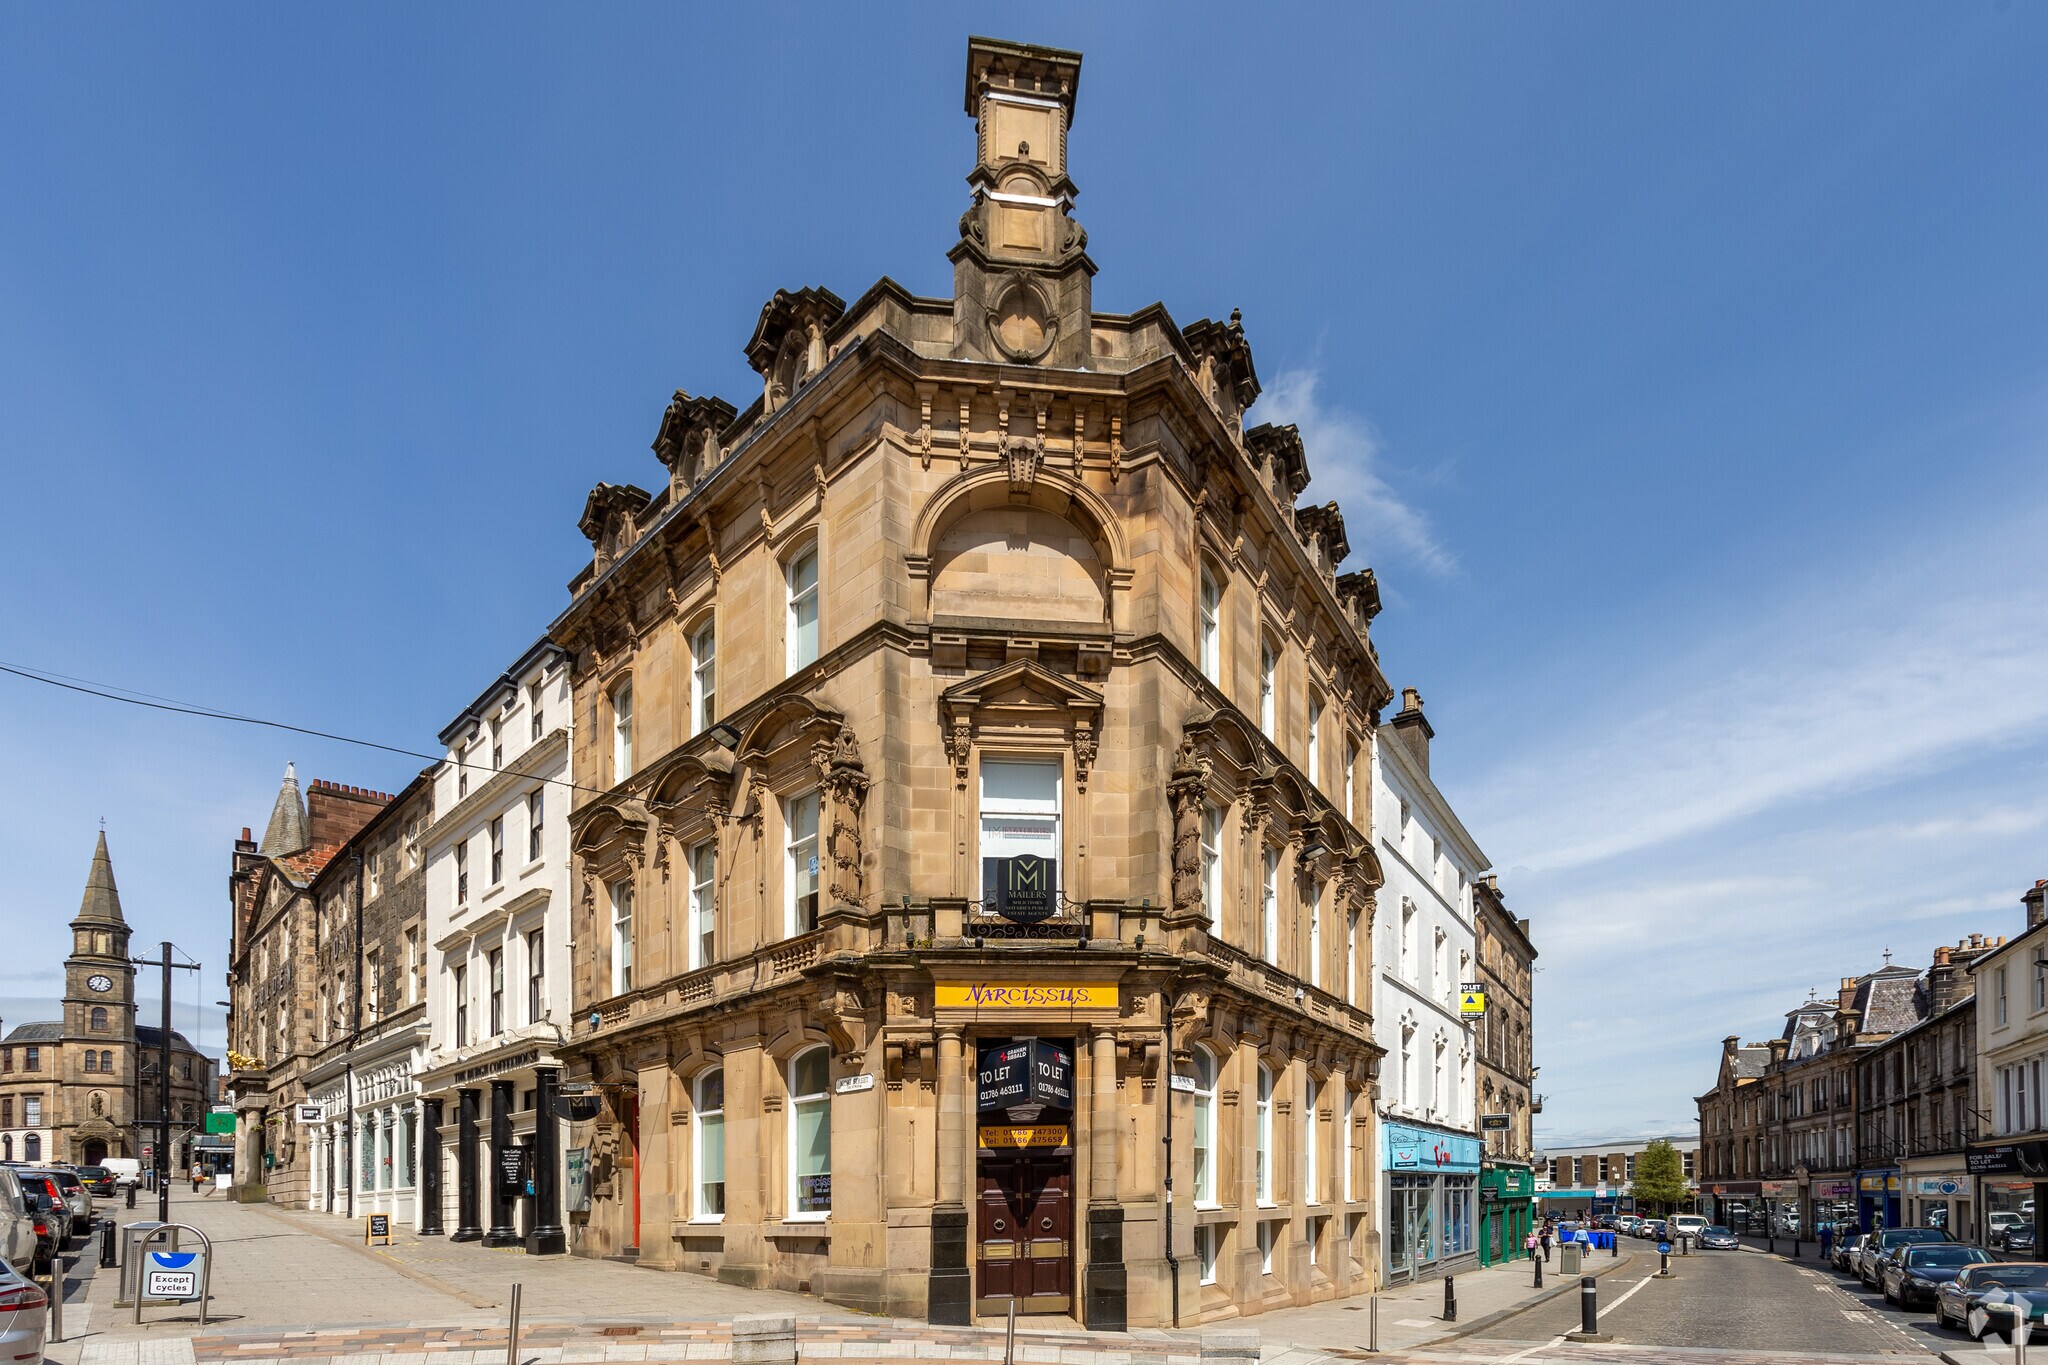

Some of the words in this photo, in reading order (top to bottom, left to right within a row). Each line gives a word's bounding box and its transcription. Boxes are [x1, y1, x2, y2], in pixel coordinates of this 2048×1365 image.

[1009, 891, 1047, 899] MAILERS
[1007, 1047, 1027, 1055] GRAHAM
[1007, 1052, 1027, 1061] SIBBALD
[980, 1071, 992, 1085] TO
[994, 1066, 1011, 1081] LET
[1038, 1062, 1050, 1076] TO
[1051, 1066, 1063, 1080] LET
[980, 1089, 999, 1100] 01786
[1000, 1083, 1024, 1096] 463111
[1038, 1082, 1054, 1094] 01786
[1032, 1136, 1063, 1144] 475658
[155, 1275, 189, 1284] Except
[155, 1284, 187, 1292] cycles
